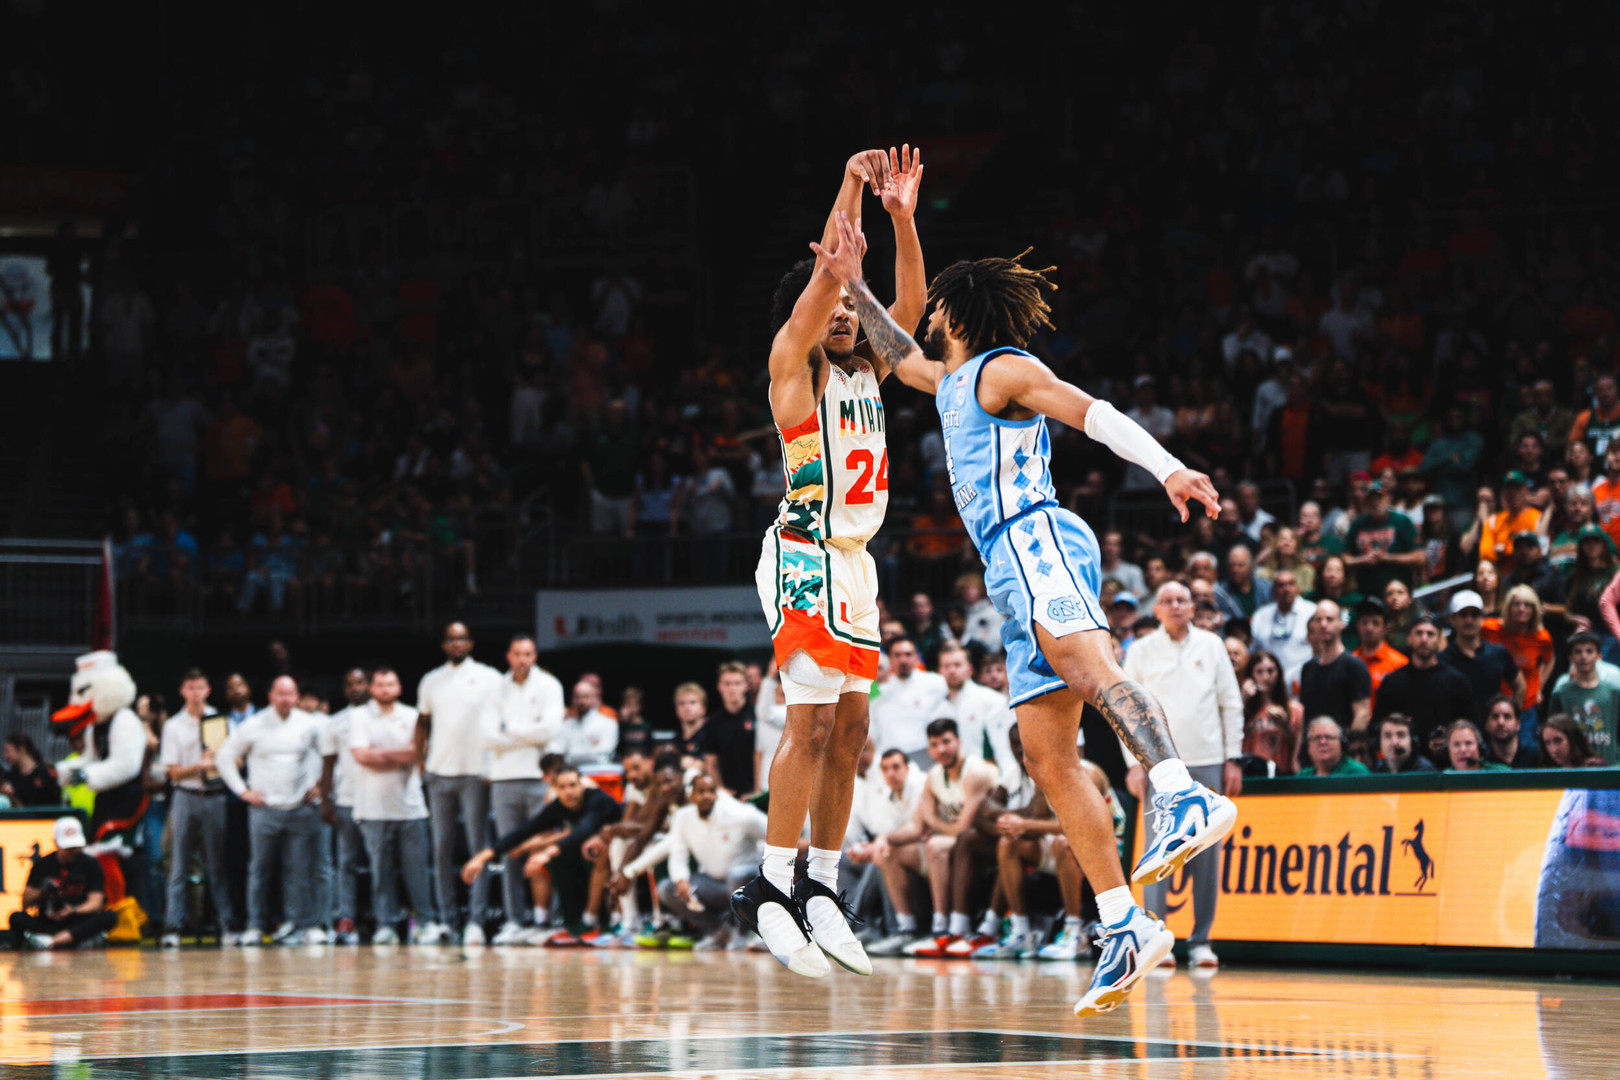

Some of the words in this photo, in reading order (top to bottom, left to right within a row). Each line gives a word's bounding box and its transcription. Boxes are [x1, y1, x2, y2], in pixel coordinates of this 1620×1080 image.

[839, 396, 885, 438] MIAM
[942, 409, 960, 430] RTH
[845, 448, 887, 504] 24
[1166, 824, 1392, 913] tinental
